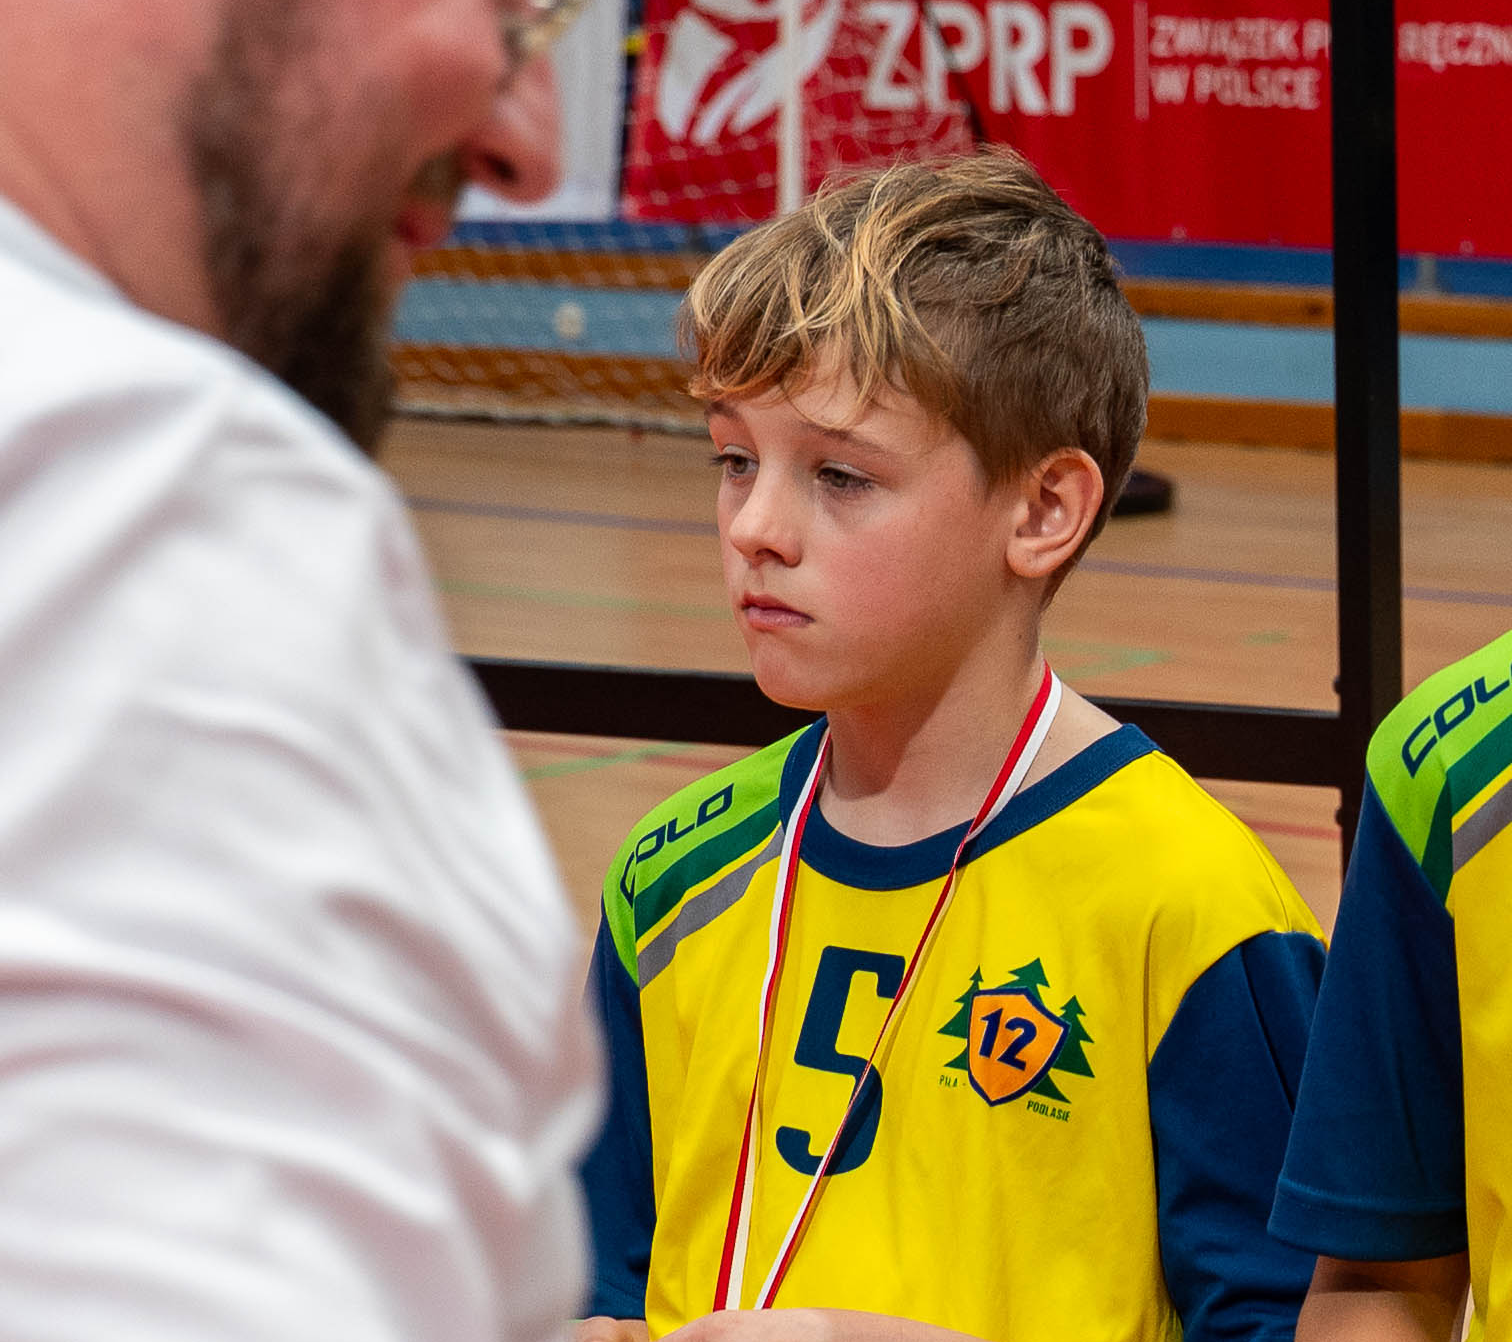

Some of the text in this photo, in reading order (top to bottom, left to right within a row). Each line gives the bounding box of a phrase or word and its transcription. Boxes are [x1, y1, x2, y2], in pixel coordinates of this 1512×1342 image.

[775, 945, 906, 1176] 5
[978, 1008, 1037, 1070] 12
[1027, 1100, 1071, 1122] PODLASIE
